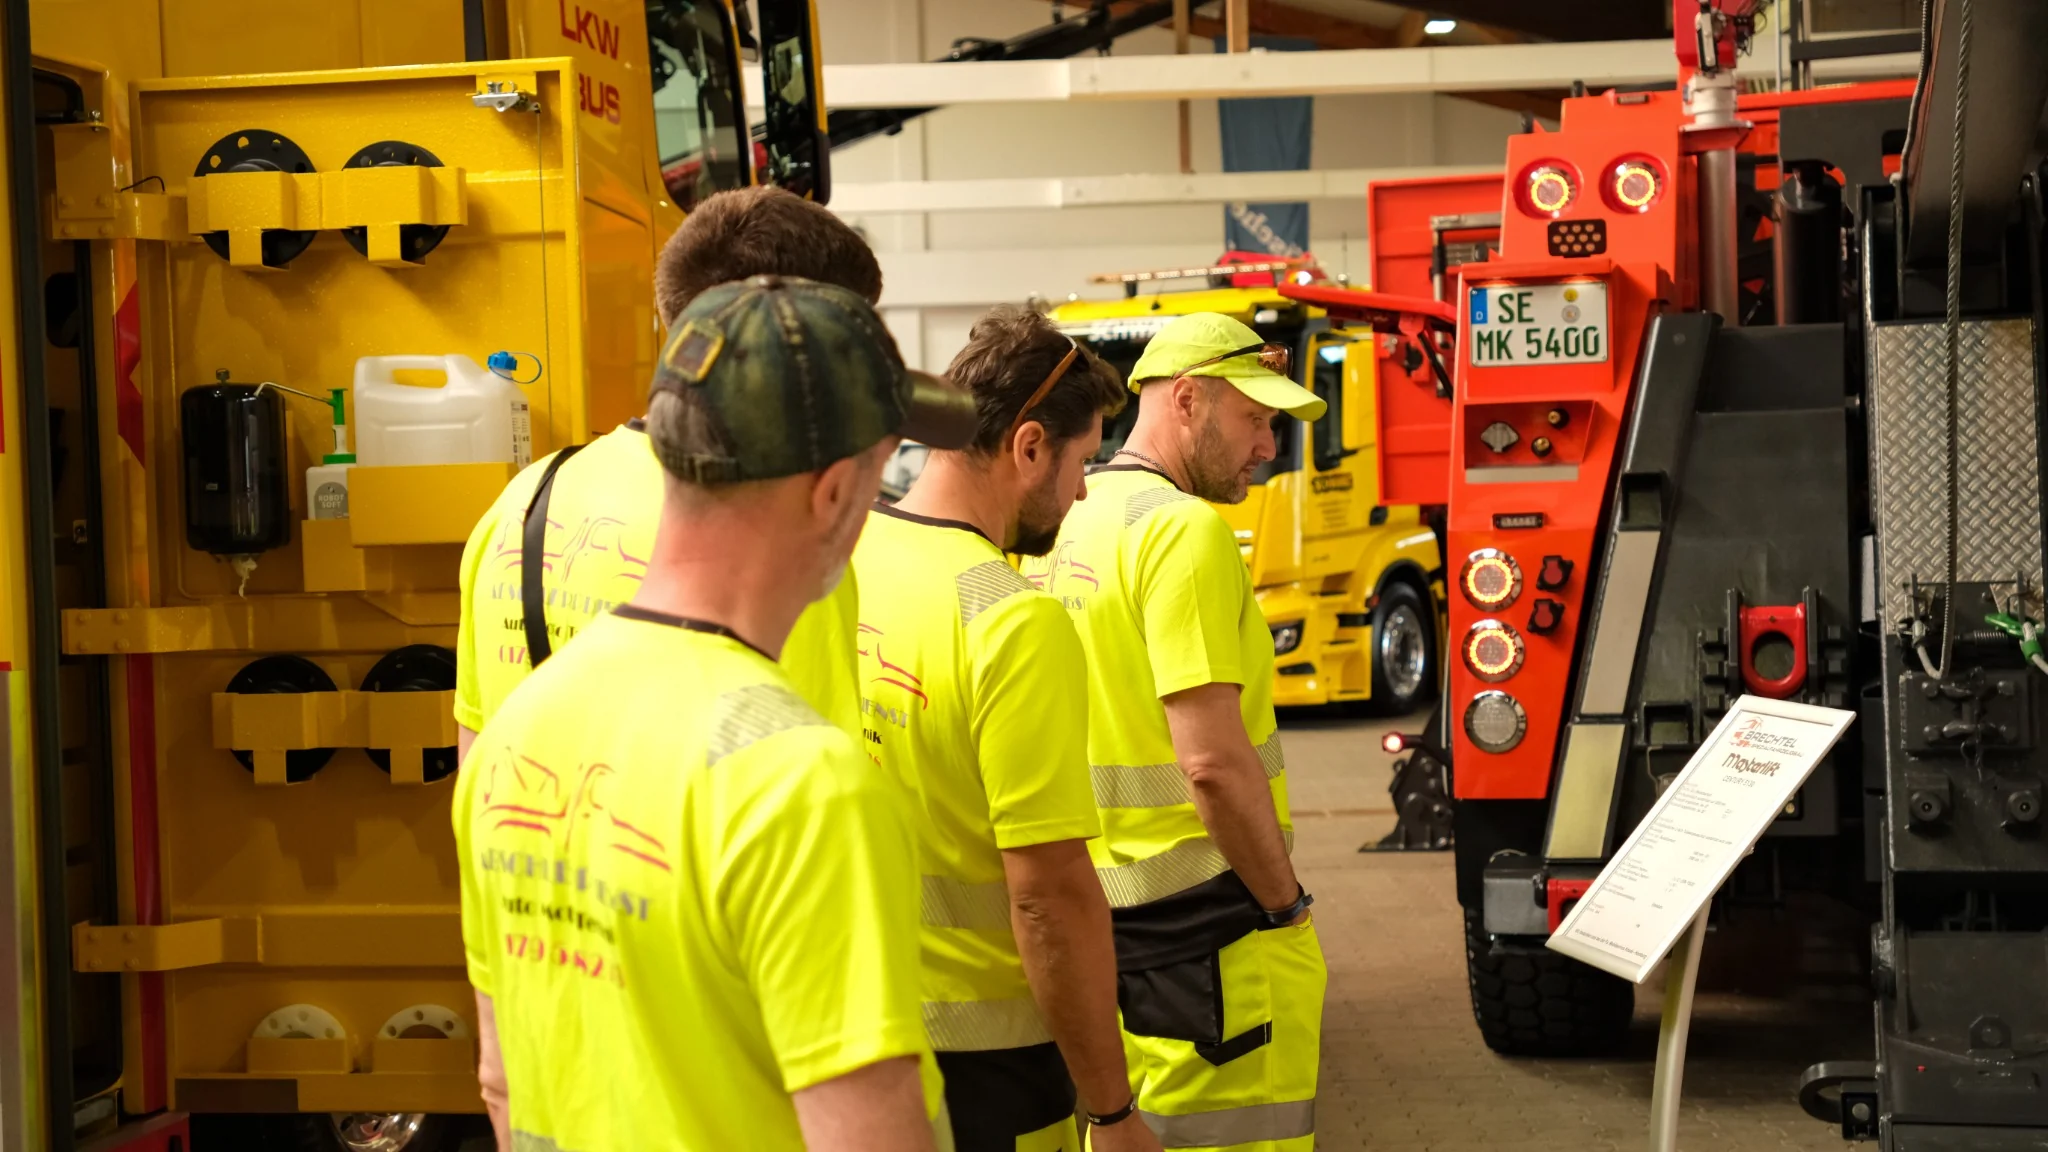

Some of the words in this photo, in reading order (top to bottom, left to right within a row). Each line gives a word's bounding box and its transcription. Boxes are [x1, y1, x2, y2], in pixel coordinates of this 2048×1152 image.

[559, 0, 619, 60] LKW
[1476, 311, 1484, 321] D
[1498, 292, 1535, 324] SE
[1477, 329, 1513, 360] MK
[1526, 326, 1600, 359] 5400
[318, 494, 344, 502] ROBOT
[321, 501, 341, 509] SOFT
[1744, 731, 1798, 748] BRECHTEL
